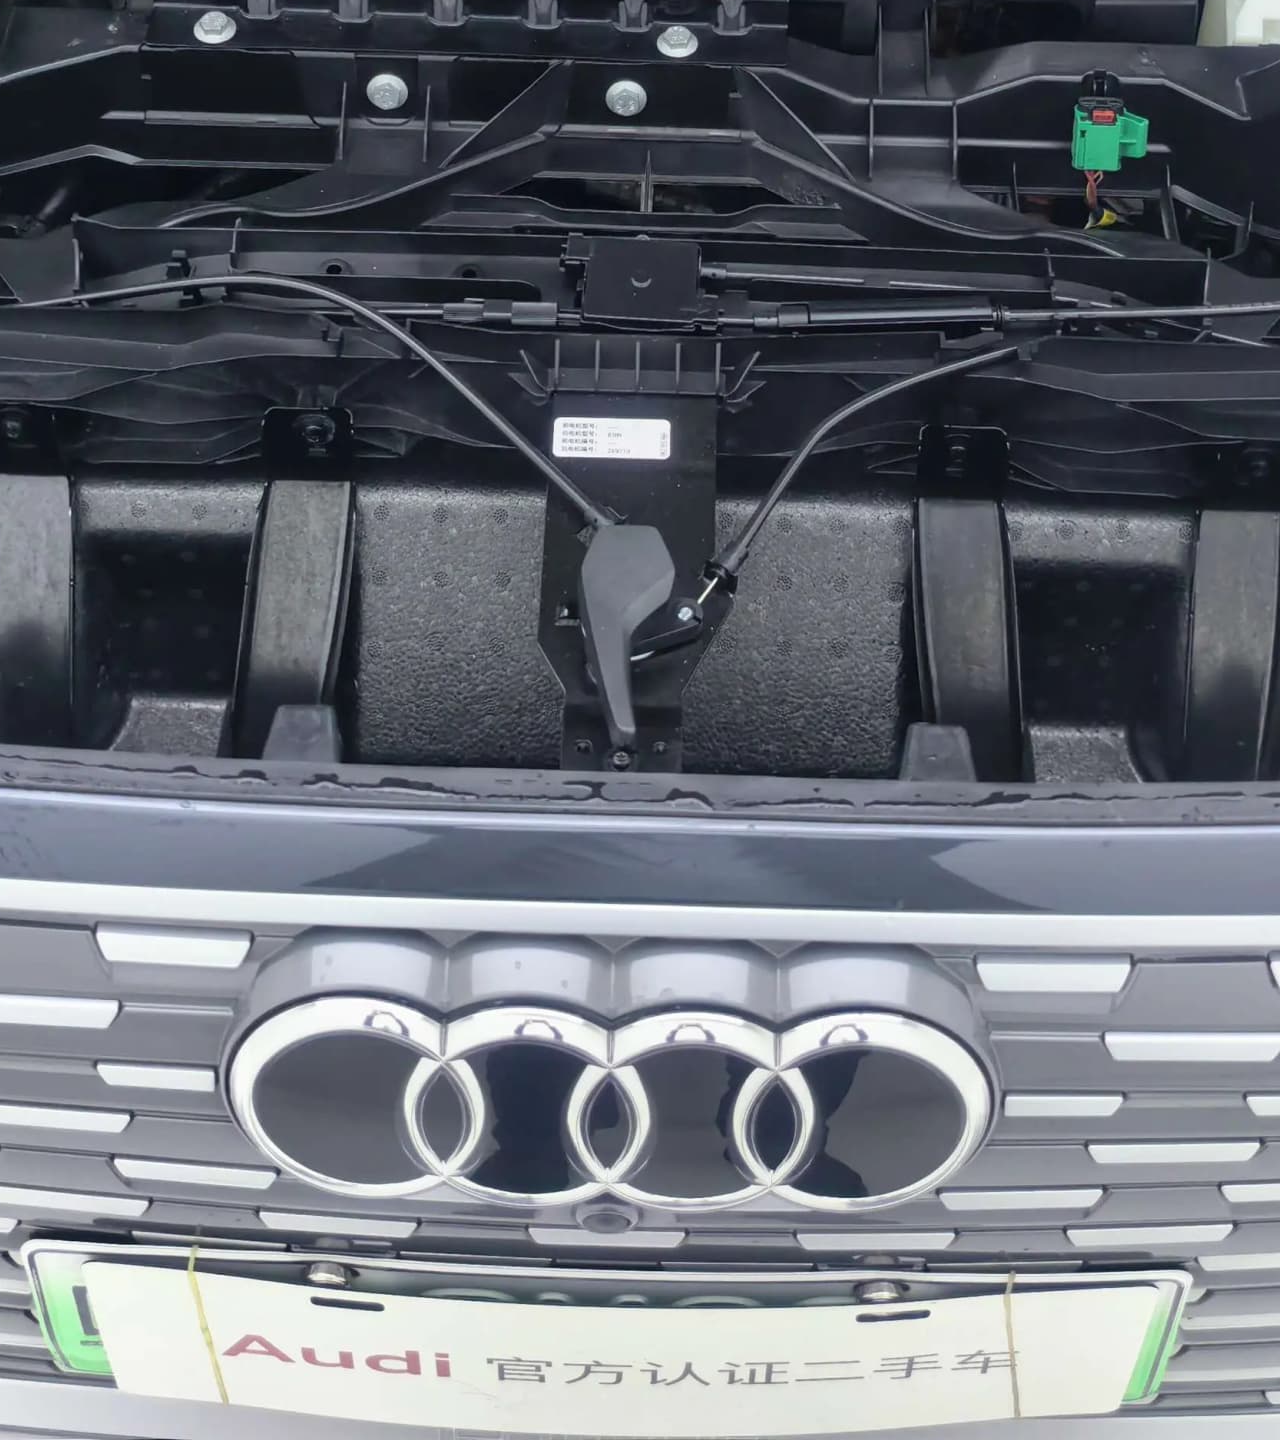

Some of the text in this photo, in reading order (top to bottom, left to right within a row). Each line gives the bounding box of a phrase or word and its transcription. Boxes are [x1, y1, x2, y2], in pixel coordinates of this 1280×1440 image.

[221, 1333, 1020, 1387] Audi 官方认证二手车
